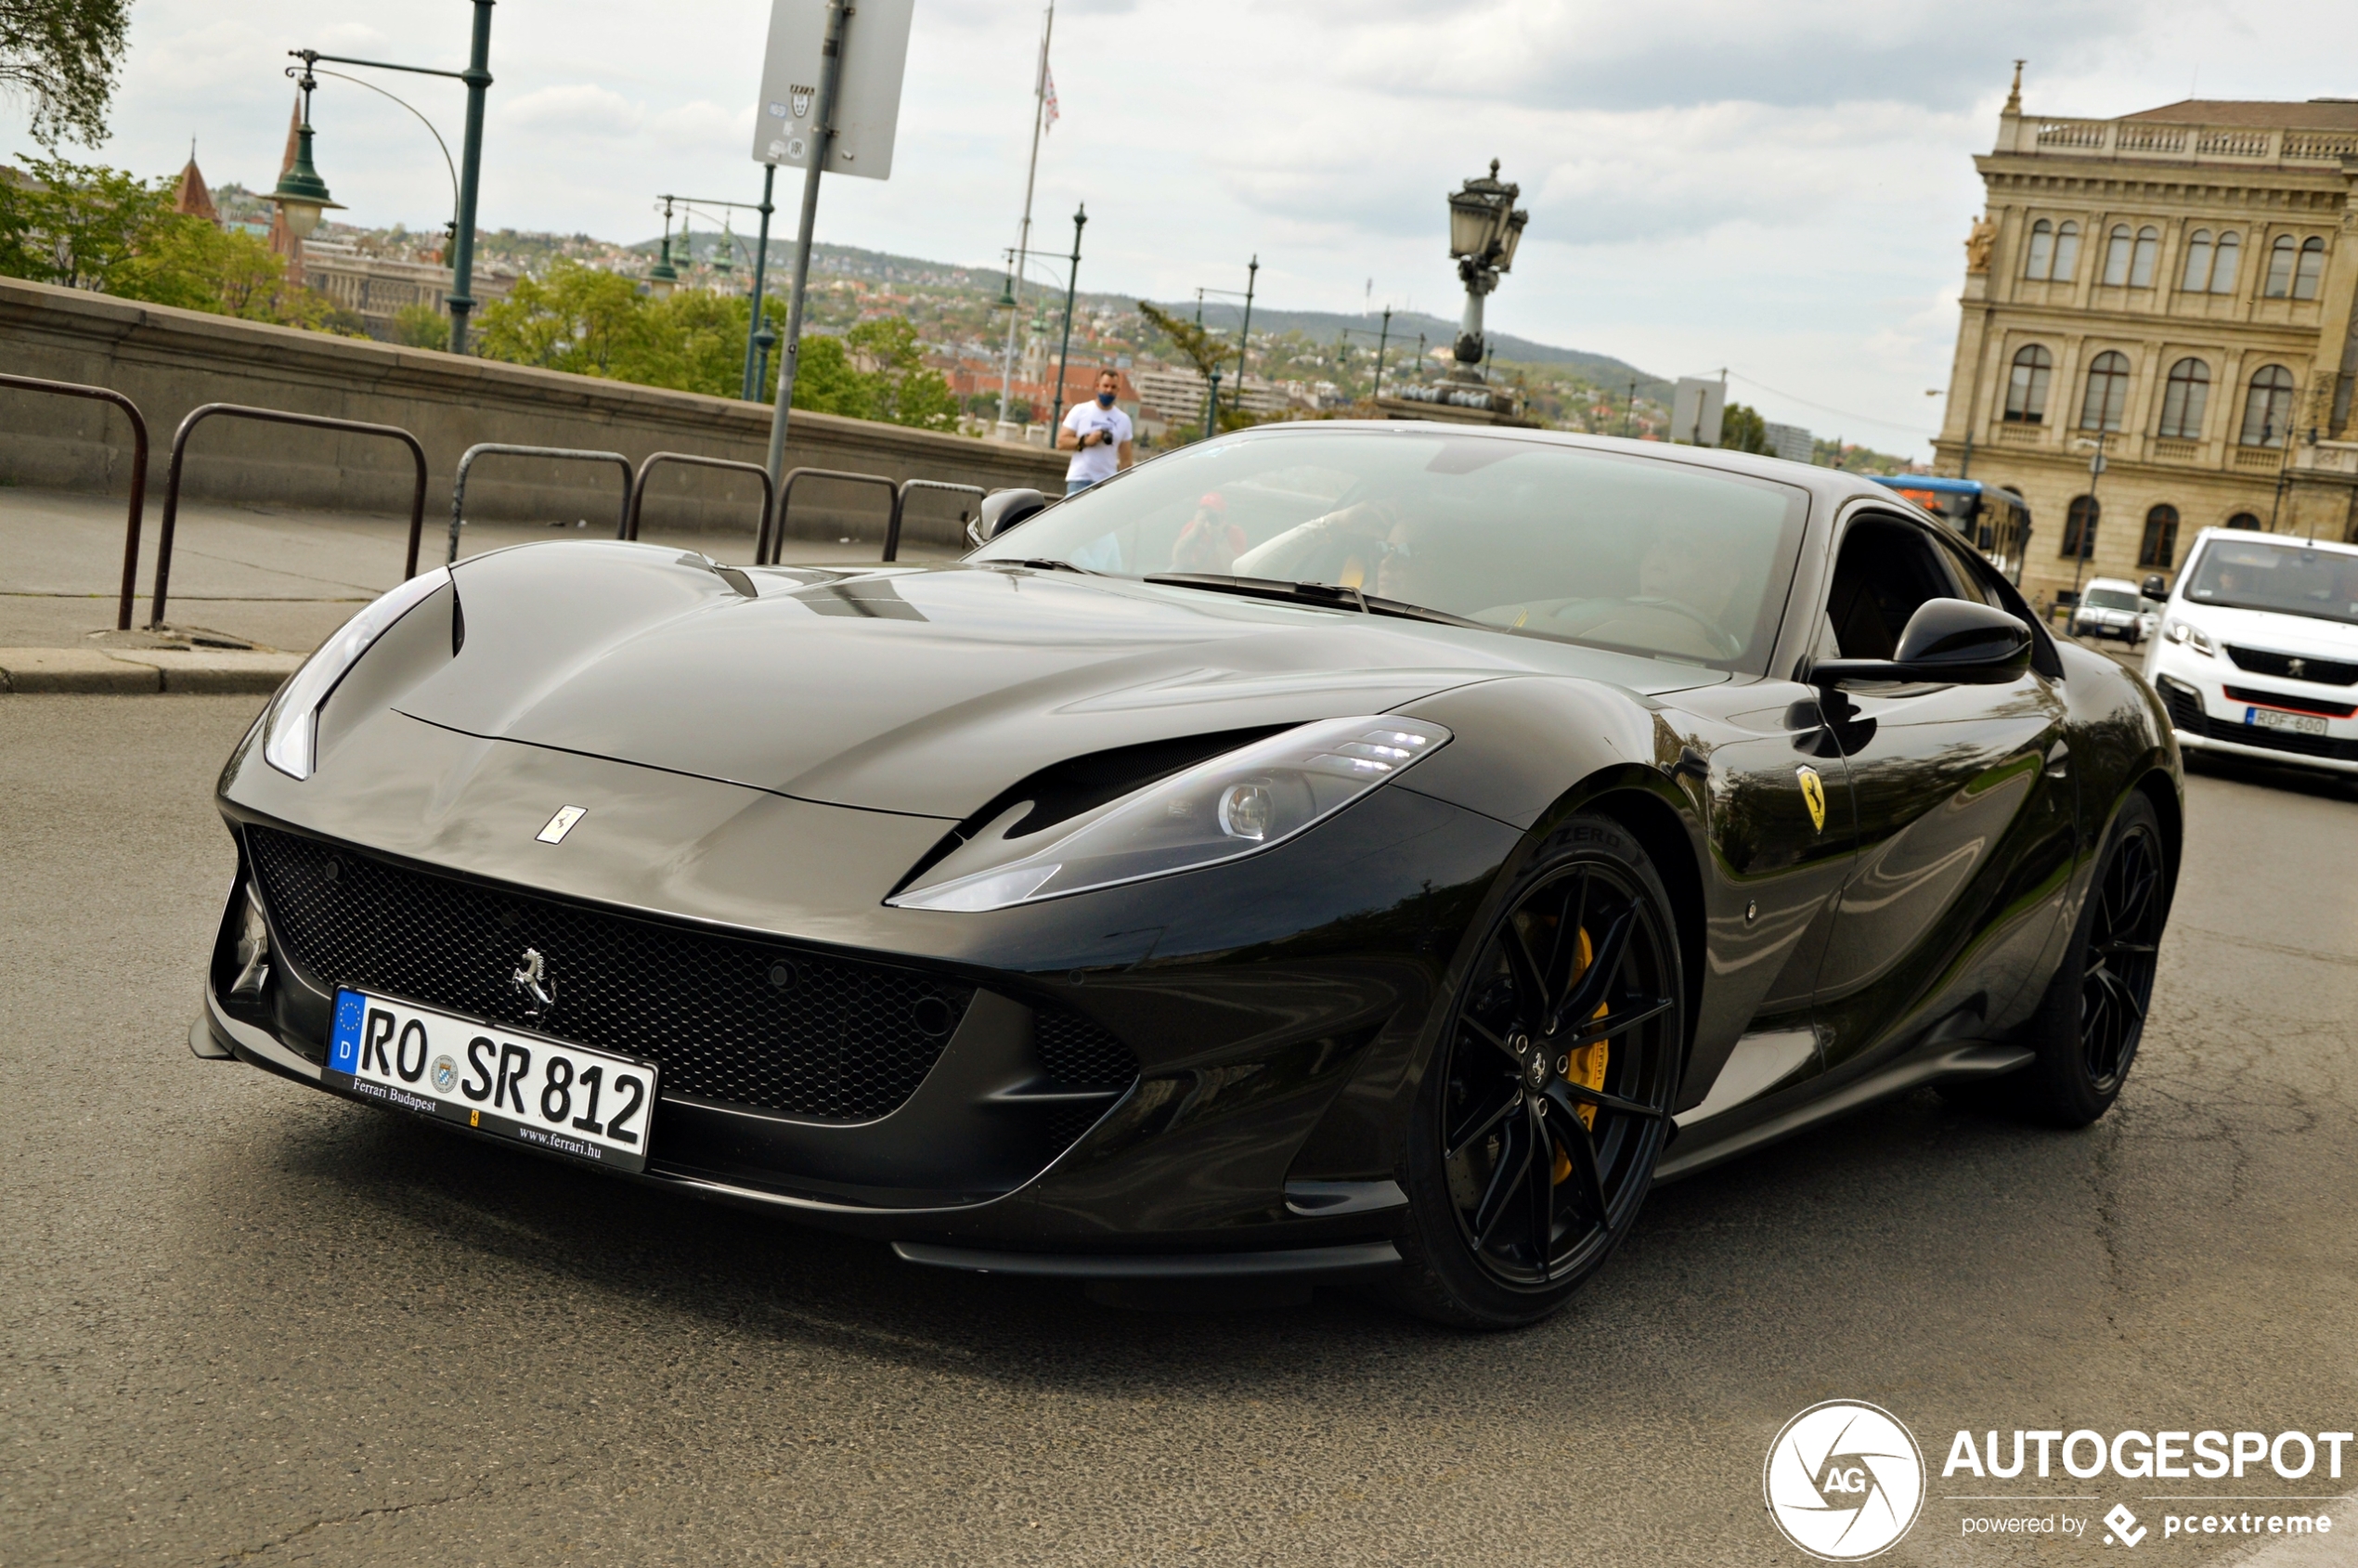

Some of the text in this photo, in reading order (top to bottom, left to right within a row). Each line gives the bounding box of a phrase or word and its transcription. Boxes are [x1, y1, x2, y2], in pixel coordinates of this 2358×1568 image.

[2257, 711, 2323, 732] RDF-600
[339, 1041, 351, 1059] D
[361, 1007, 428, 1082] RO
[461, 1036, 531, 1114] SR
[540, 1056, 646, 1145] 812
[353, 1077, 436, 1112] Ferrari Budapest
[519, 1128, 602, 1159] www.ferrari.hu
